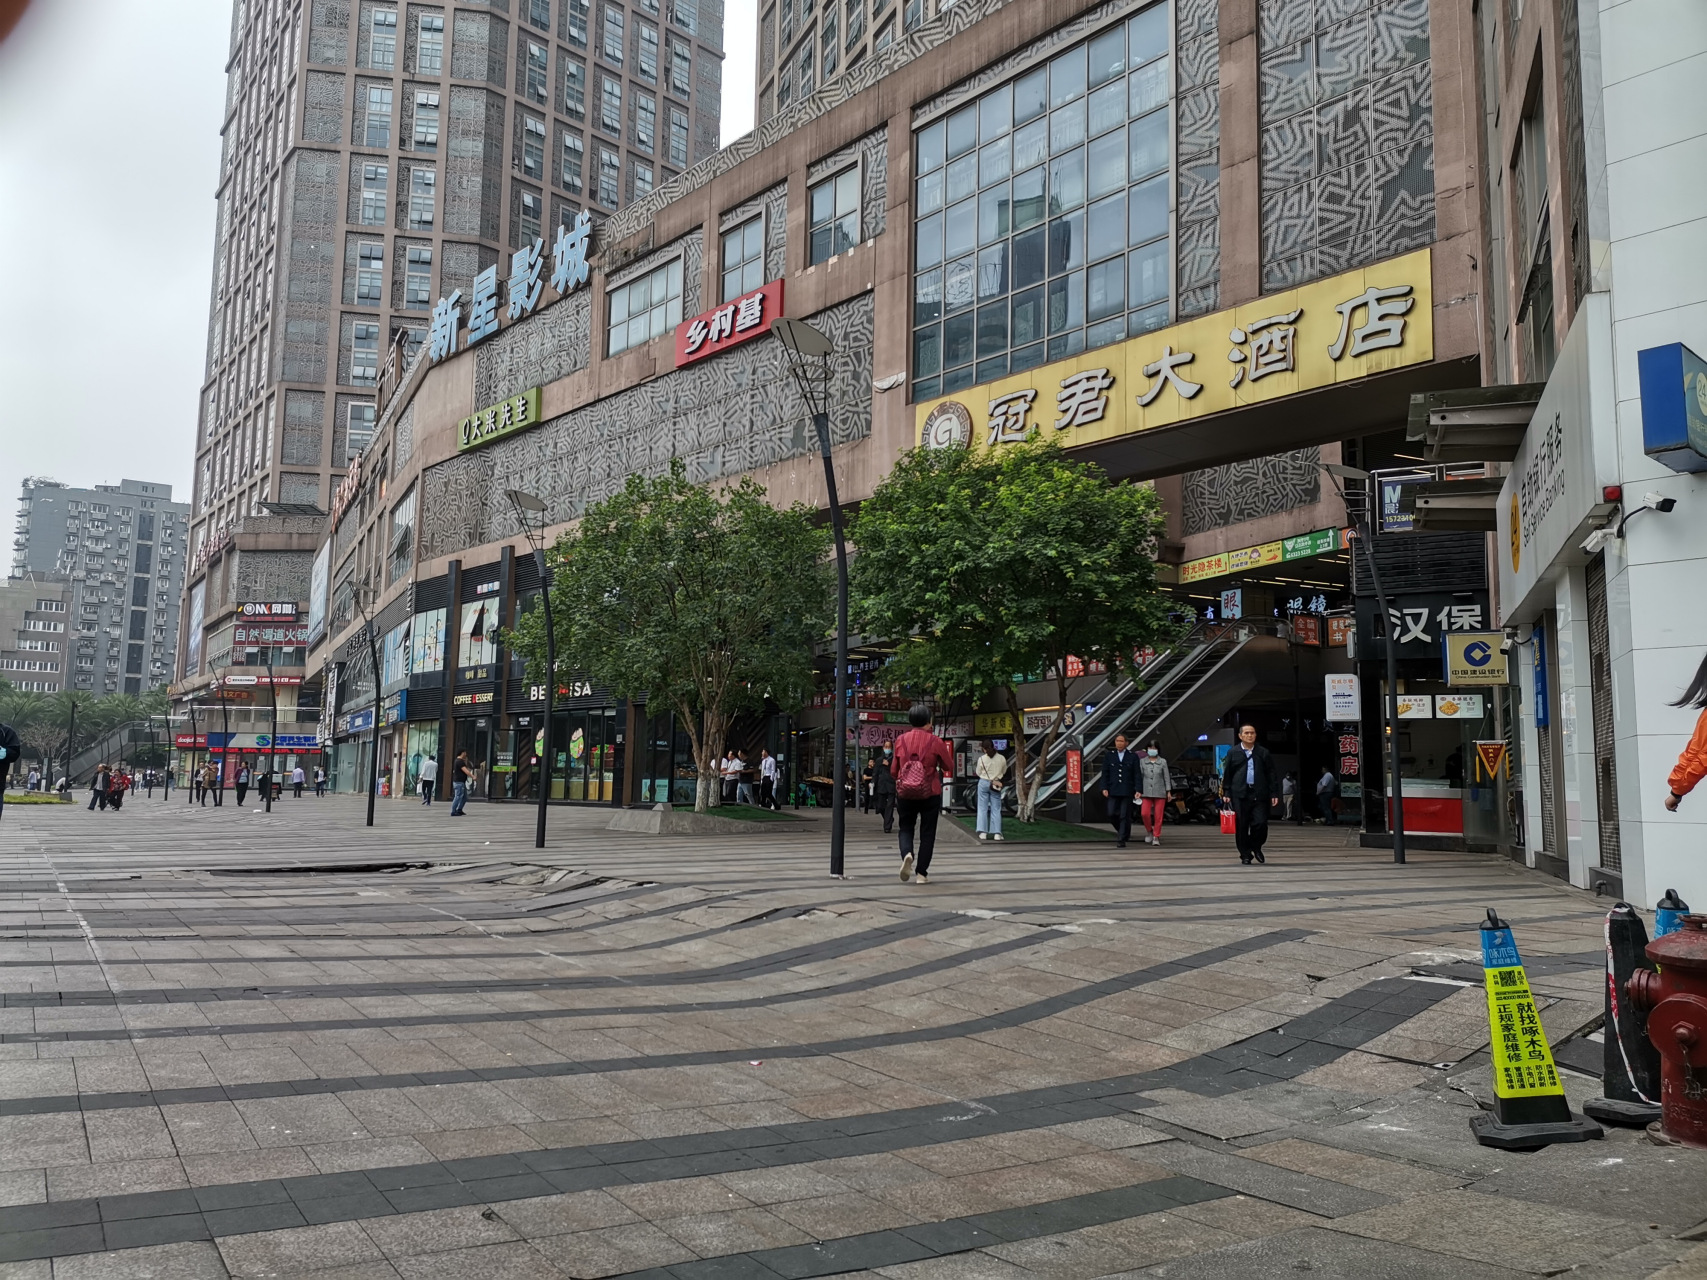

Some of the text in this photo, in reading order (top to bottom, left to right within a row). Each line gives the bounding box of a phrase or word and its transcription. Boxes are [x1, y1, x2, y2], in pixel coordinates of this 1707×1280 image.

[429, 209, 592, 362] 新星影城
[684, 292, 764, 354] 乡村基
[987, 285, 1415, 446] 冠君大酒店
[471, 396, 528, 440] 大米先生
[1521, 411, 1563, 524] 自助银行服务
[1523, 468, 1565, 548] Self Service Banking
[1388, 604, 1482, 644] 汉保
[453, 694, 473, 705] COFFEE
[1451, 668, 1504, 676] 中国建设银行
[1339, 734, 1359, 776] 药房
[1488, 946, 1516, 959] 啄木鸟
[1497, 1003, 1522, 1063] 正规家庭维修
[1516, 1002, 1545, 1062] 就找啄木鸟
